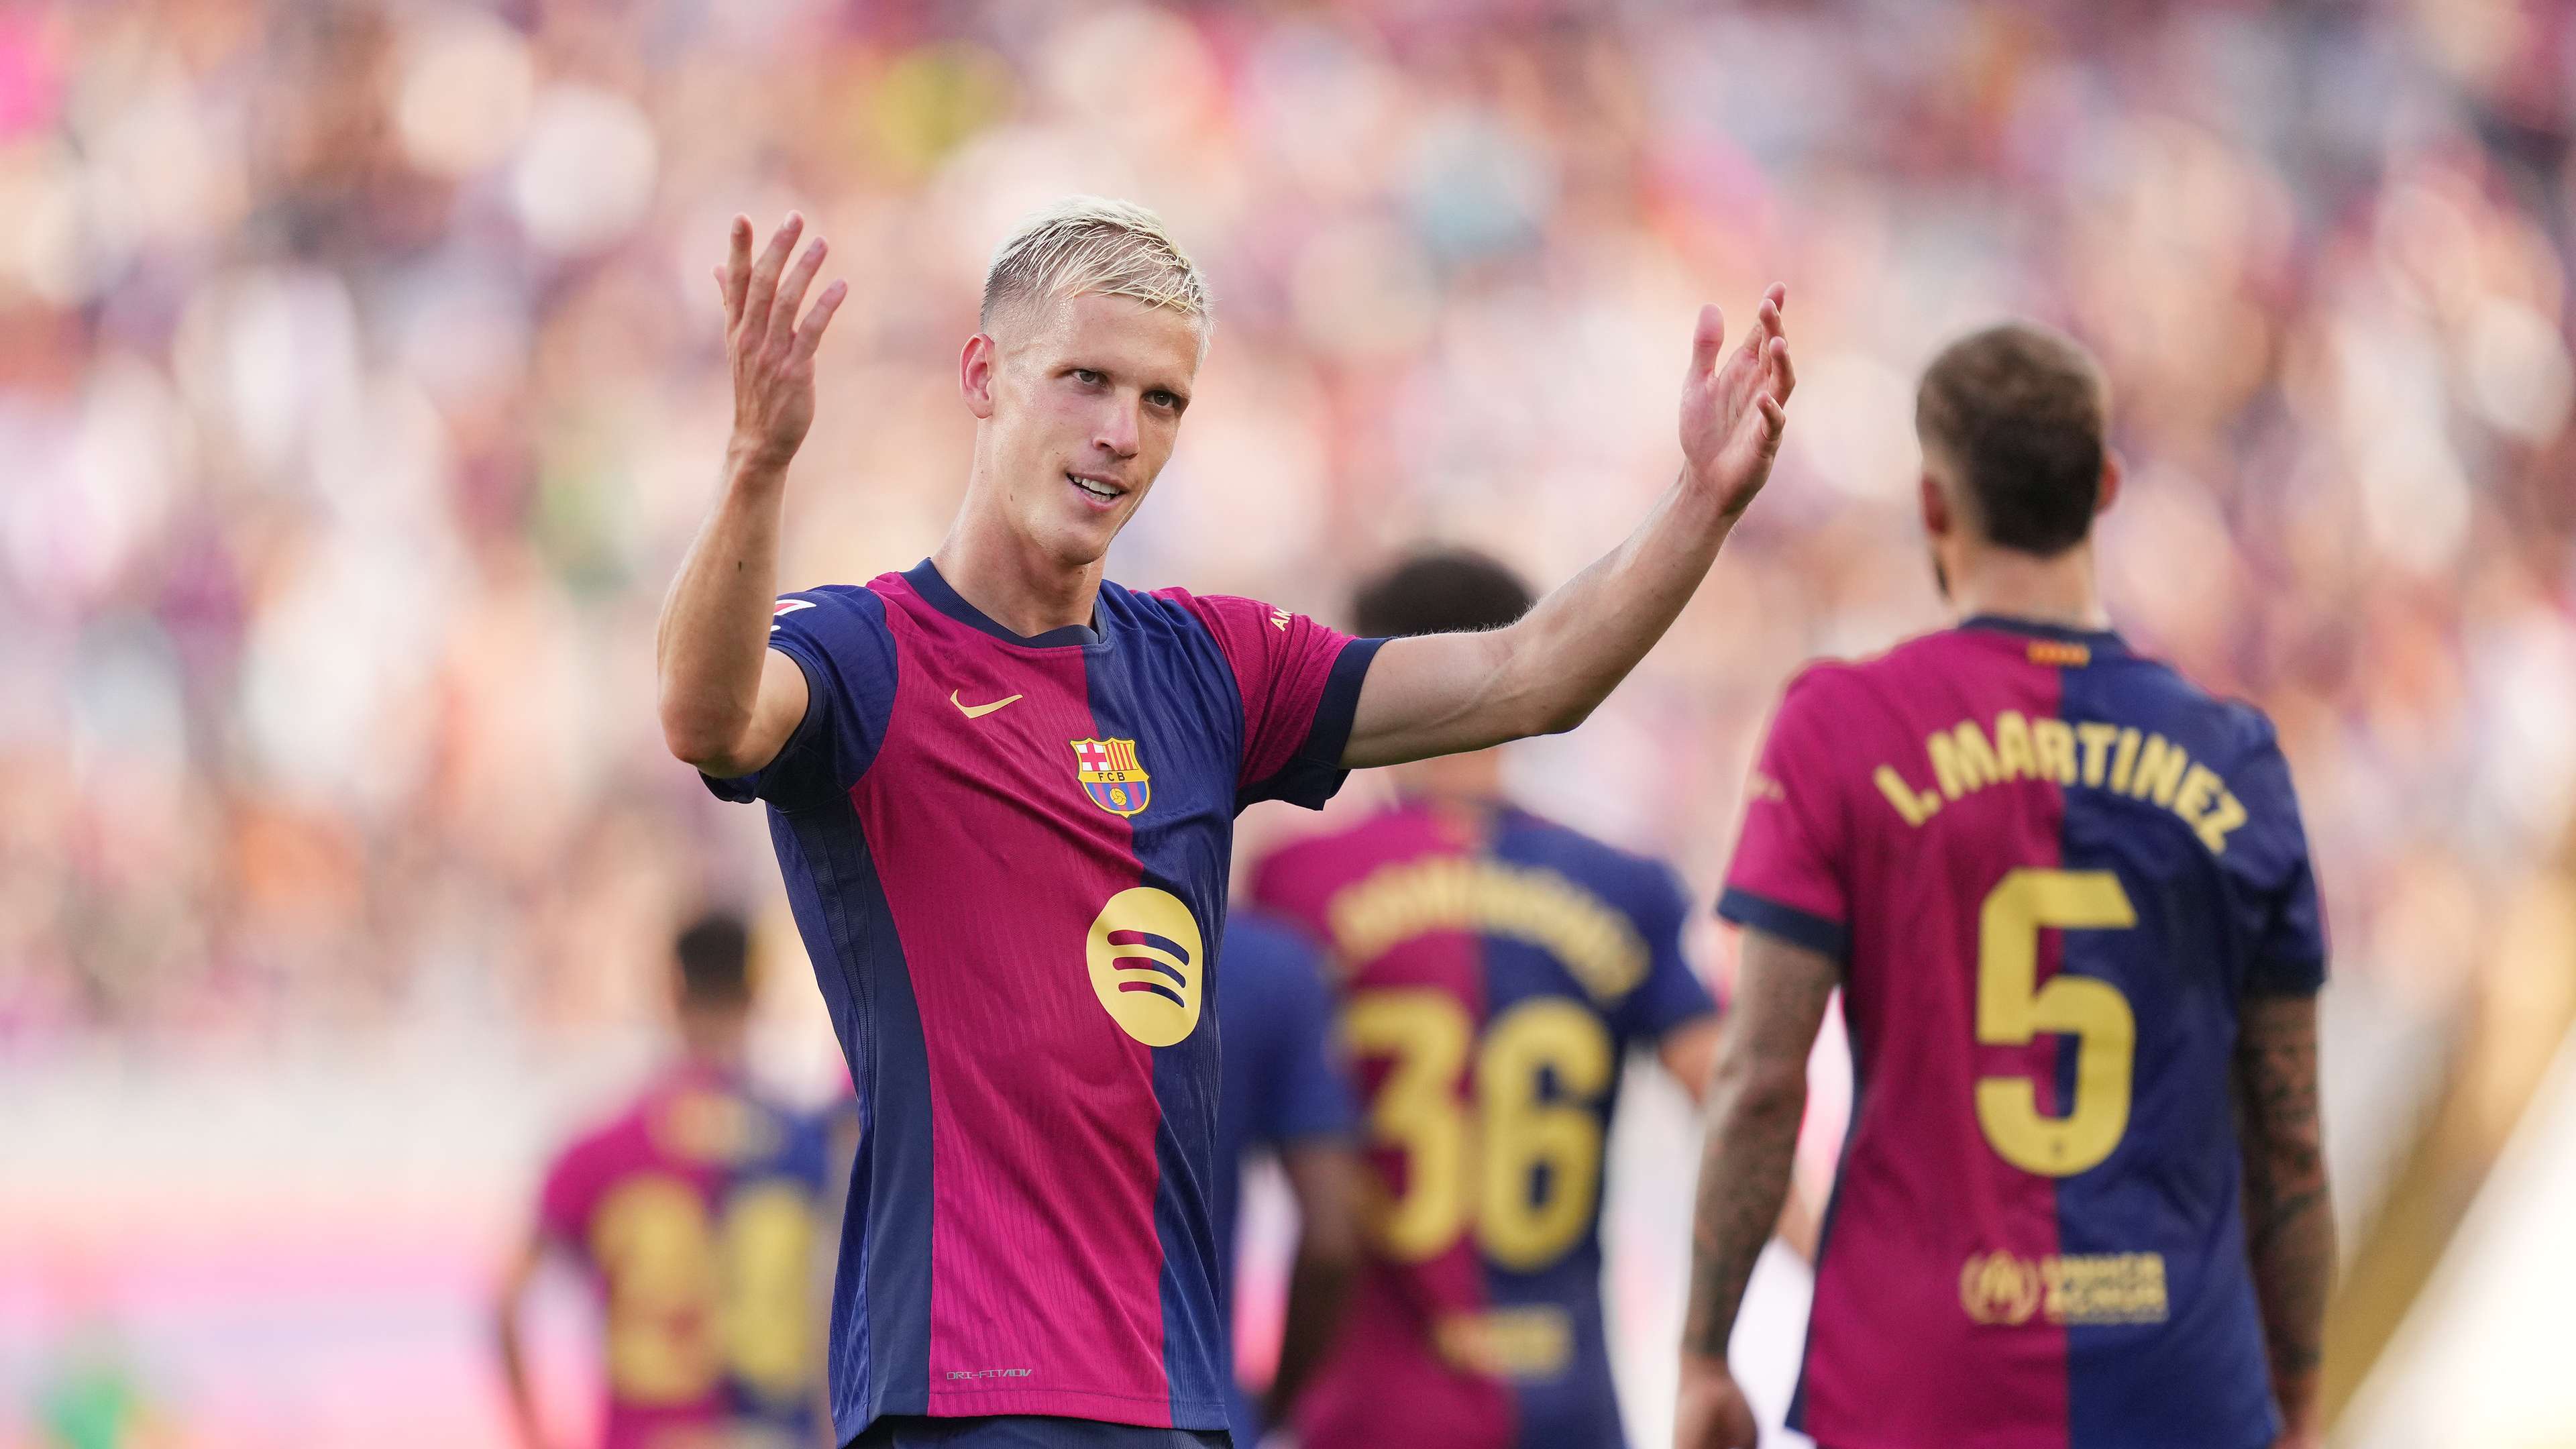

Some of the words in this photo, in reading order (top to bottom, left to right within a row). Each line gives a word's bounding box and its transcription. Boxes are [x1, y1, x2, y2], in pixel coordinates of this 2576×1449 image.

[1097, 772, 1126, 782] FCB
[1344, 986, 1609, 1271] 36
[1974, 867, 2138, 1177] 5
